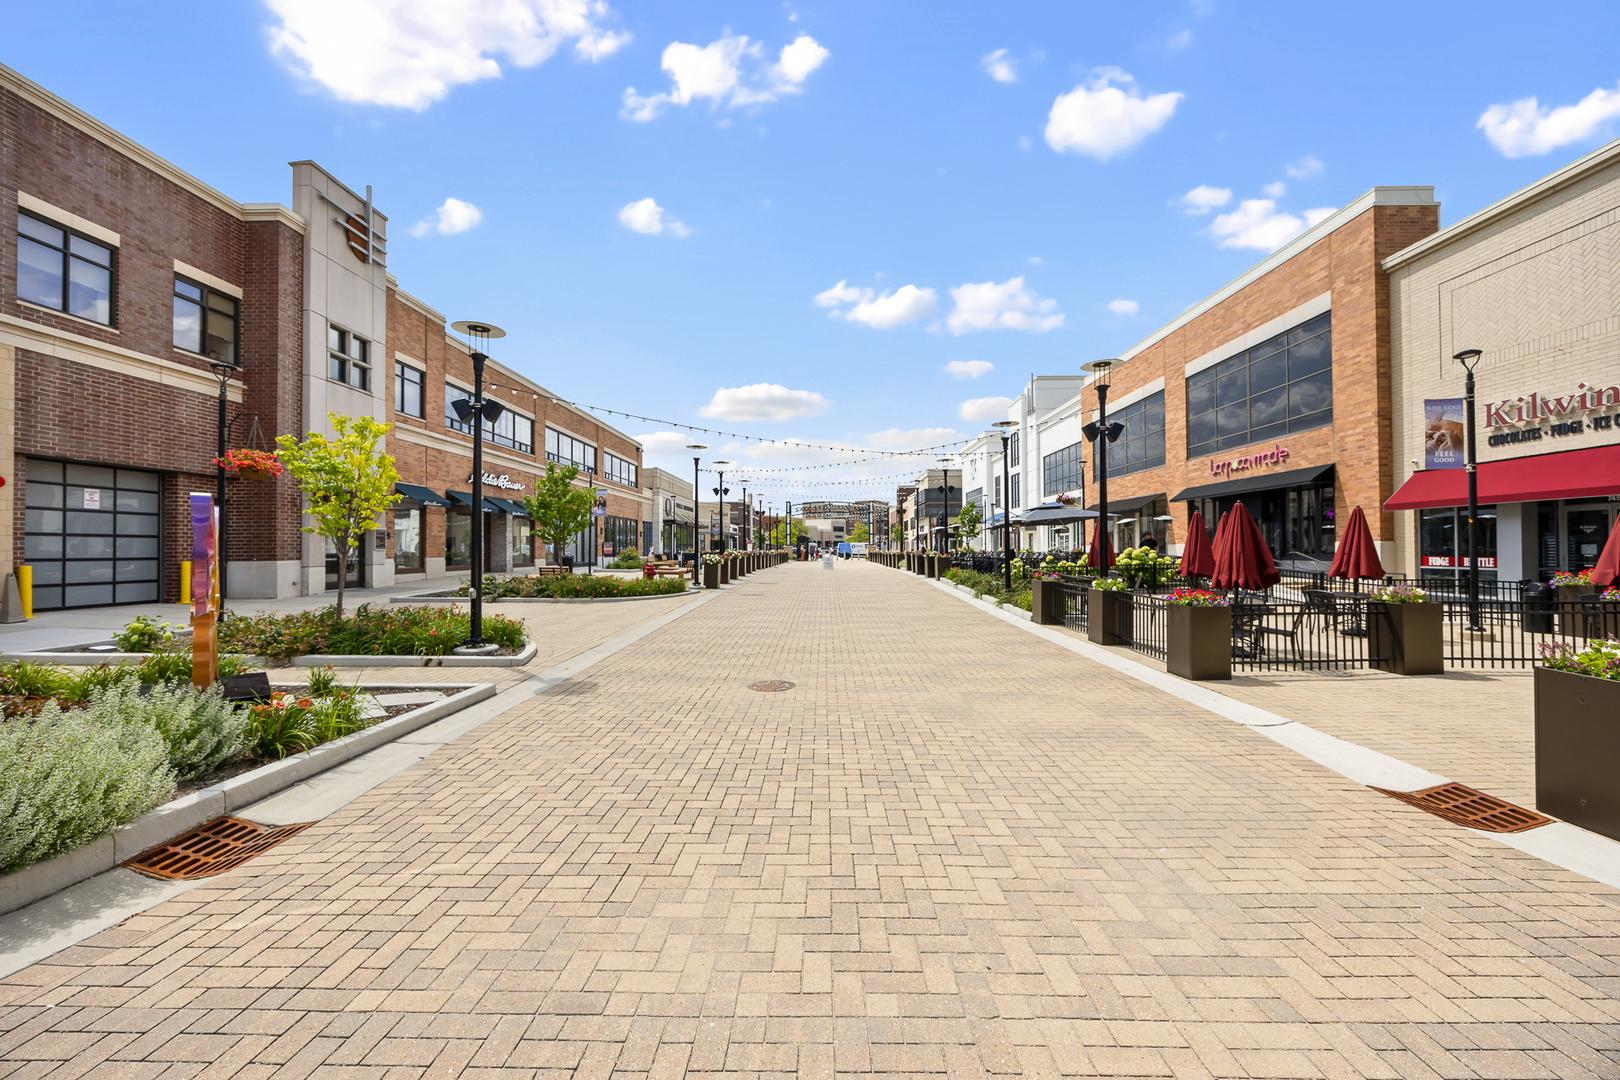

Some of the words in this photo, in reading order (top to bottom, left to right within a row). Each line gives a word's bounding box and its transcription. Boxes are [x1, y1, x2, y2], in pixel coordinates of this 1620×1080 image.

[1488, 427, 1543, 447] CHOCOLATES
[1550, 420, 1584, 437] FUDGE
[1592, 415, 1611, 431] ICE
[1428, 556, 1450, 566] FUDGE
[1463, 557, 1495, 567] BTTLE
